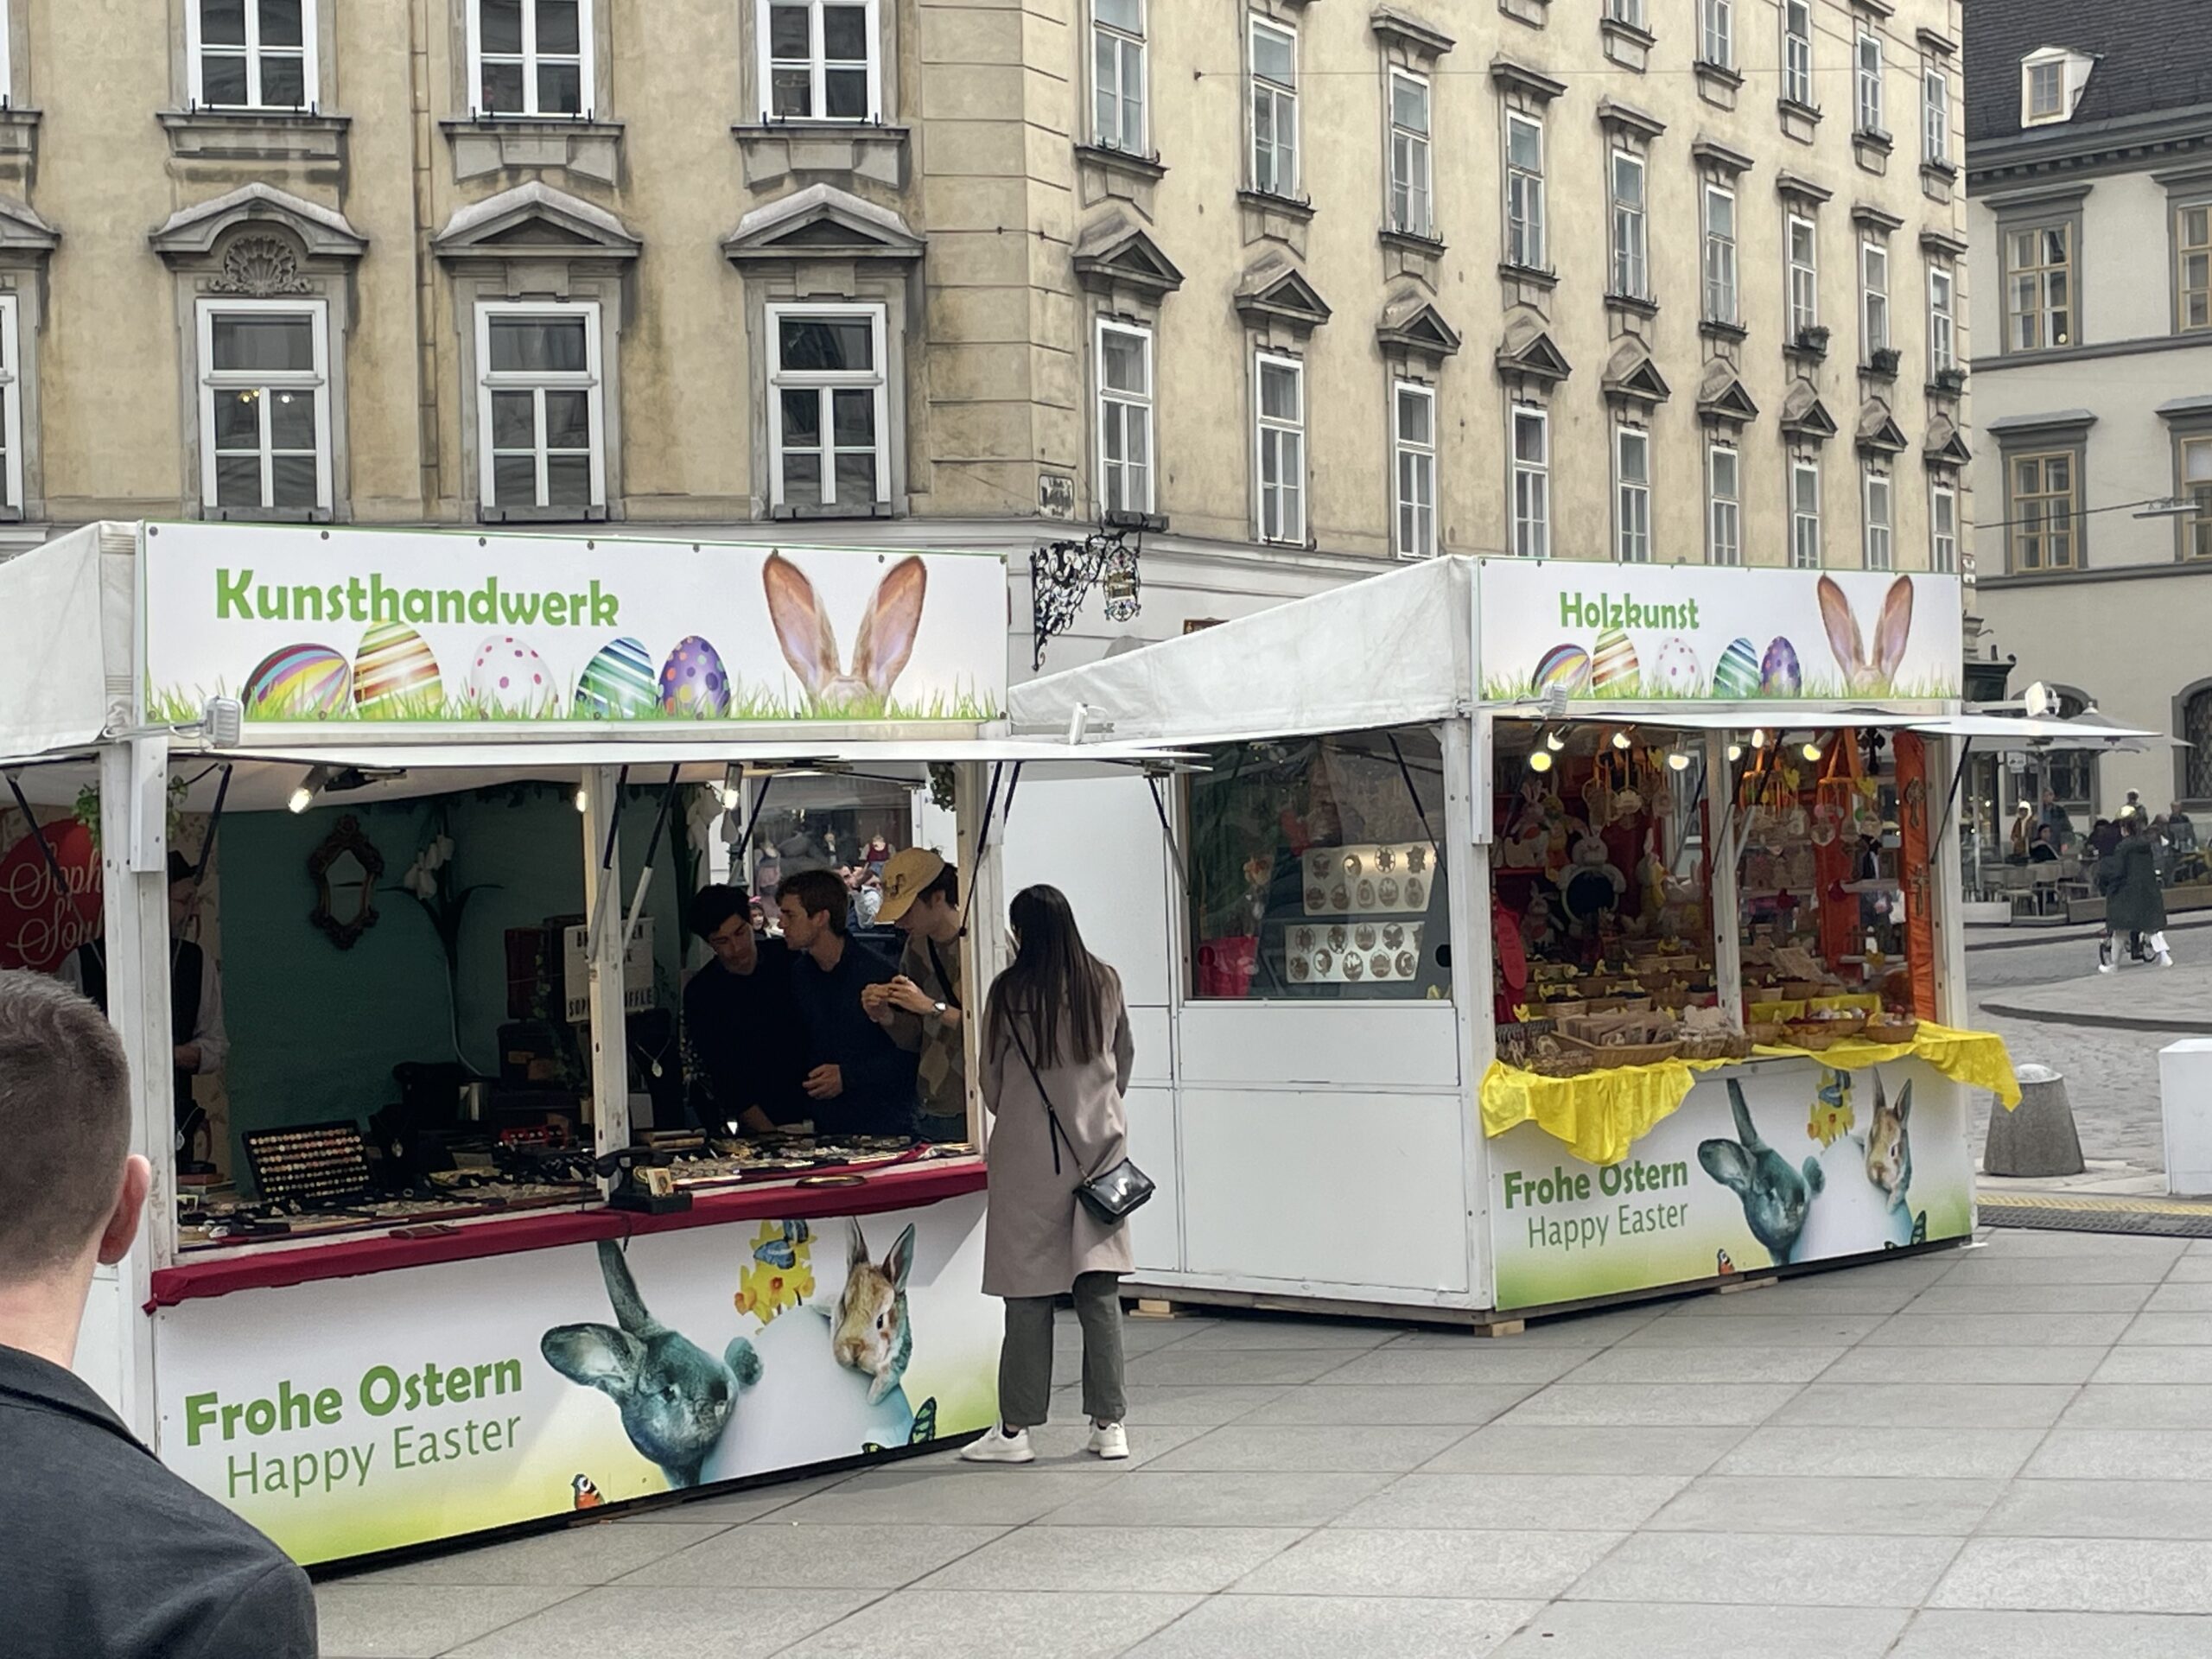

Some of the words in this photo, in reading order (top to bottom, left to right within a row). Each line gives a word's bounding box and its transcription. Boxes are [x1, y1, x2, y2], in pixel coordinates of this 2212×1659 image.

[217, 569, 619, 626] Kunsthandwerk
[1560, 592, 1700, 631] Holzkunst
[1504, 1166, 1591, 1208] Frohe
[1599, 1160, 1688, 1196] Ostern
[1529, 1215, 1609, 1250] Happy
[1619, 1202, 1688, 1234] Easter
[186, 1381, 341, 1446] Frohe
[359, 1357, 522, 1415] Ostern
[227, 1441, 374, 1498] Happy
[393, 1414, 522, 1470] Easter
